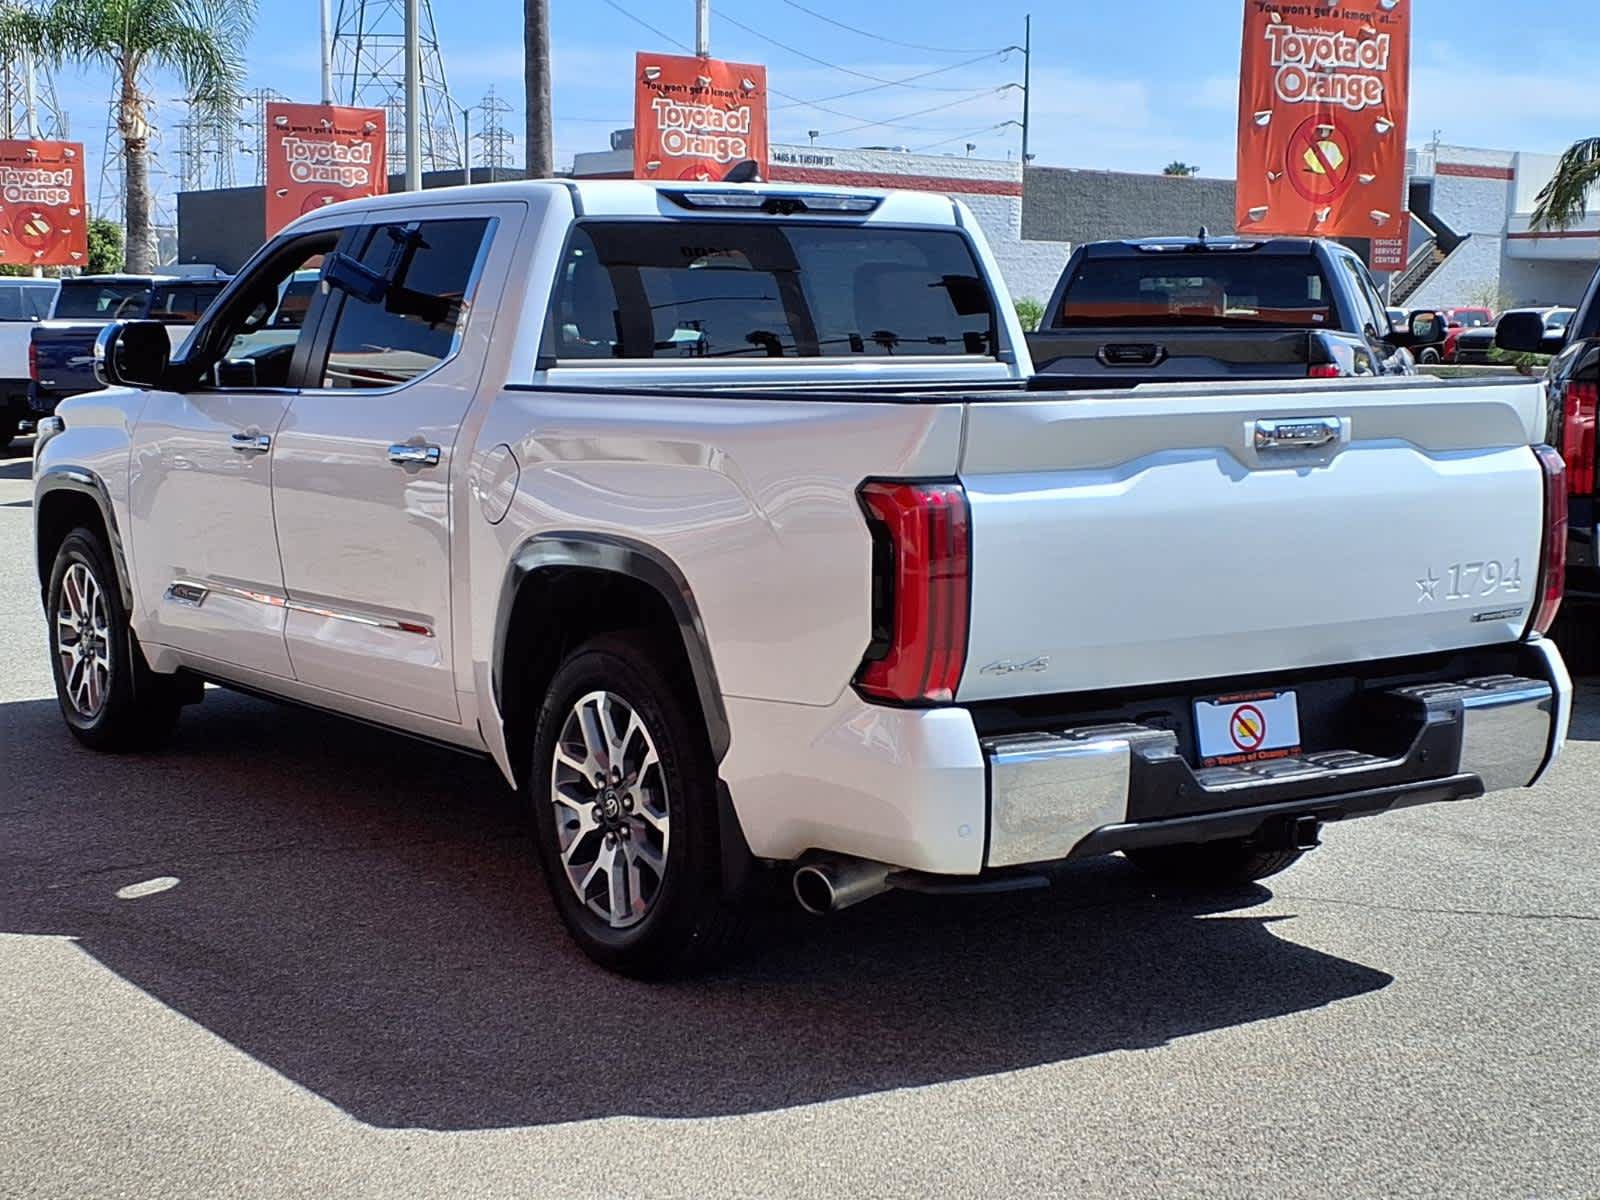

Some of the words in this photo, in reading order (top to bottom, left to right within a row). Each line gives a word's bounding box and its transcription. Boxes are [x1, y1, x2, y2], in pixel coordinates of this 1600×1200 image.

[1281, 5, 1311, 15] won't
[1265, 25, 1360, 69] Toyota
[1360, 33, 1390, 71] of
[1275, 63, 1384, 111] Orange
[653, 99, 726, 131] Toyota
[726, 106, 750, 133] of
[282, 138, 350, 162] Toyota
[350, 142, 371, 164] of
[661, 127, 747, 164] Orange
[0, 166, 54, 186] Toyota
[290, 160, 368, 188] Orange
[3, 184, 70, 206] Orange
[1375, 256, 1401, 264] CENTER
[1446, 556, 1521, 599] 1794
